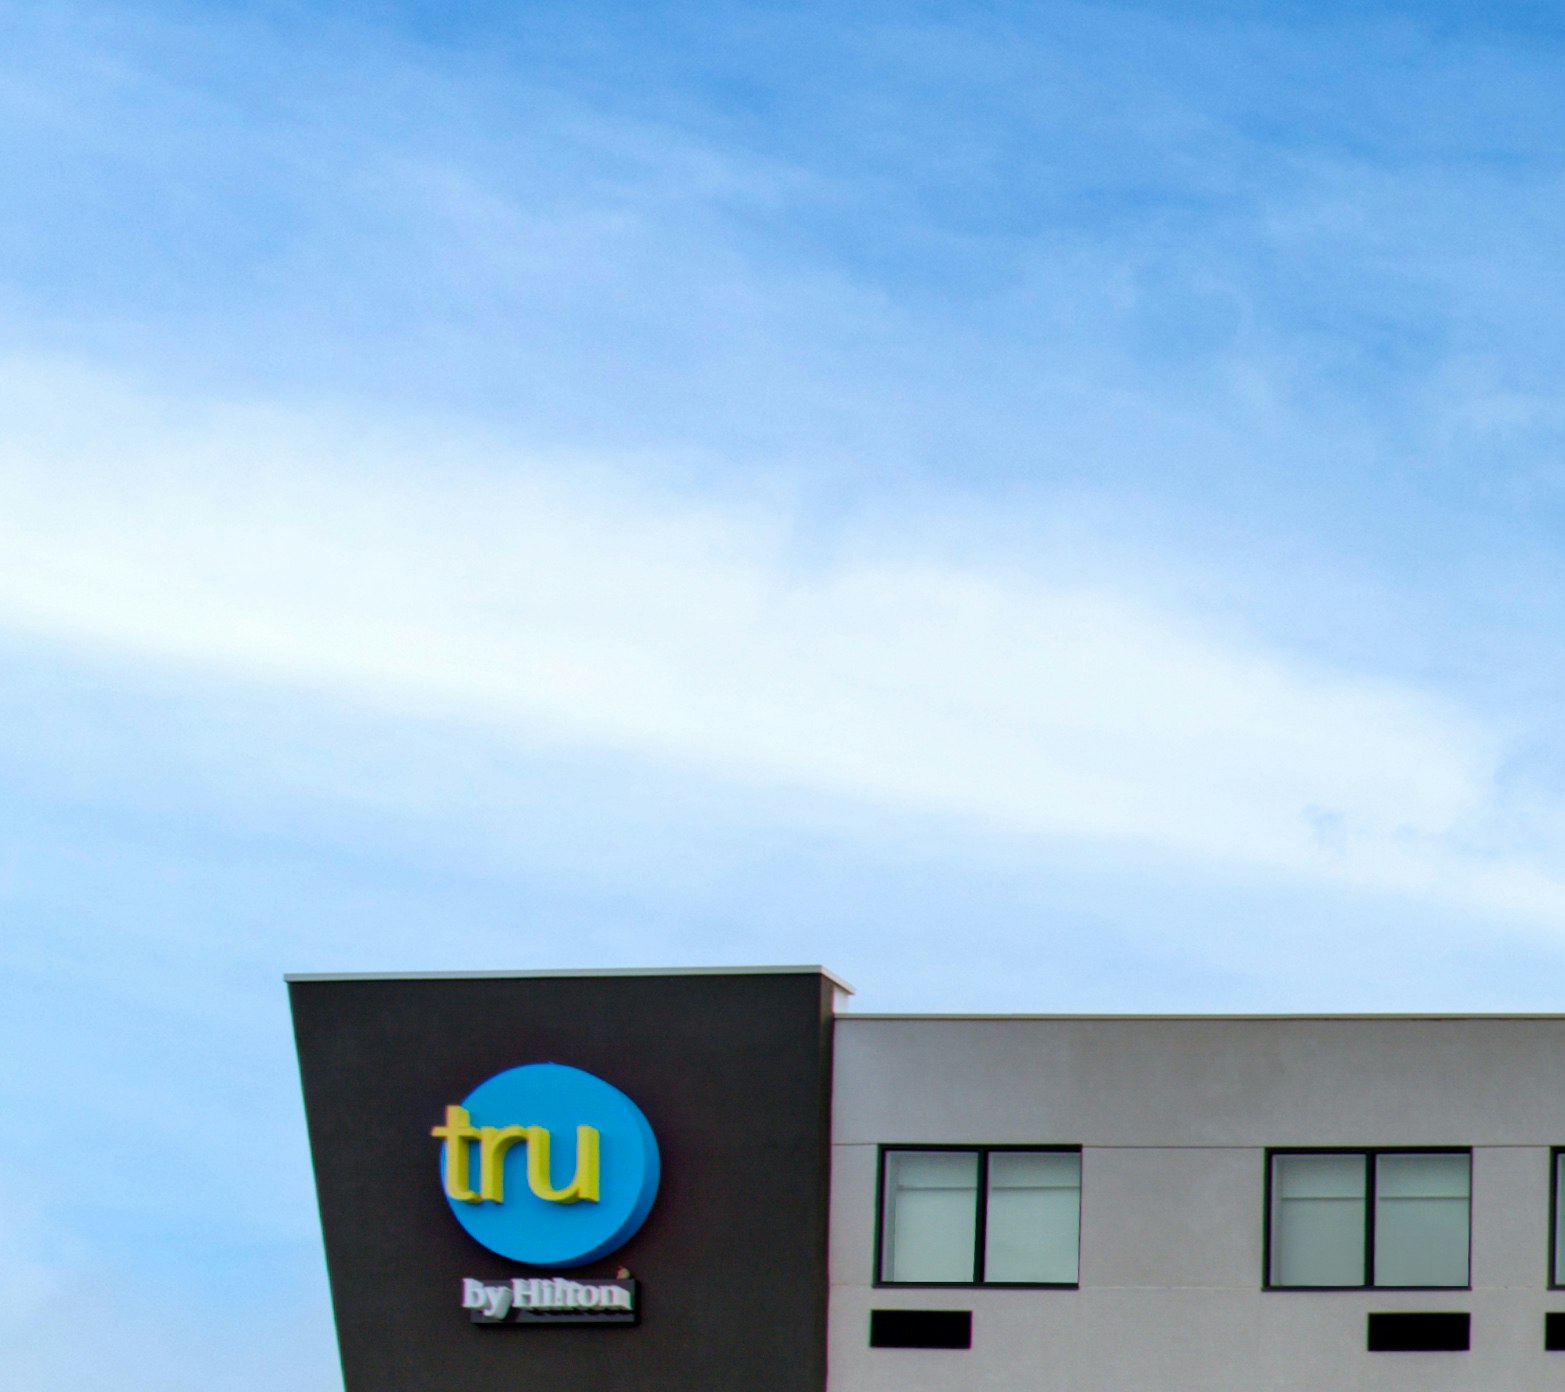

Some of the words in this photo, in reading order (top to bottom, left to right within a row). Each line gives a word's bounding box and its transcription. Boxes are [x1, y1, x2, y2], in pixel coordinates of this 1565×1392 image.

[431, 1104, 600, 1204] tru
[462, 1278, 511, 1320] by
[512, 1277, 633, 1311] Hilton
